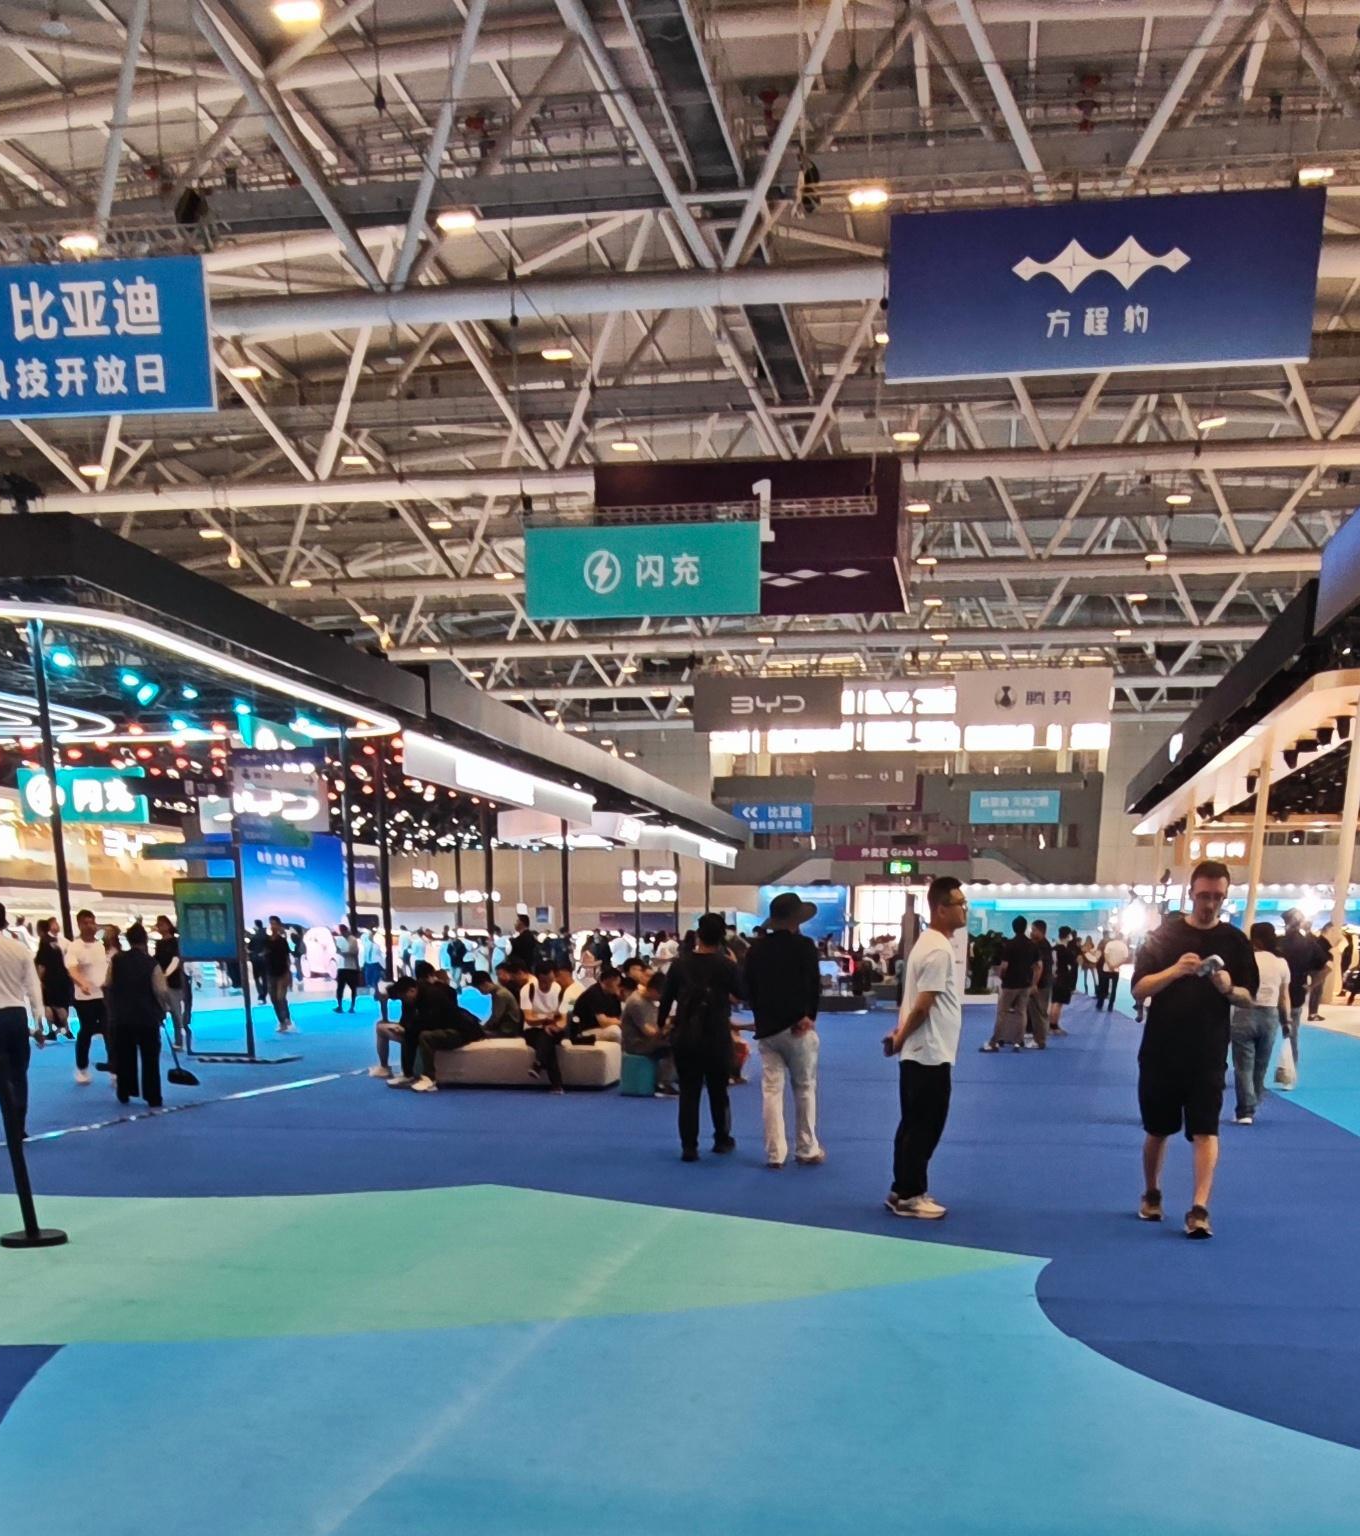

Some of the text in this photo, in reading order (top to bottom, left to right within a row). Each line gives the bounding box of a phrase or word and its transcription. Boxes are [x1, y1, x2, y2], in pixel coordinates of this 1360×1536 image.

[9, 275, 163, 342] 比亚迪
[1045, 304, 1150, 339] 方程豹
[635, 552, 701, 588] 闪充
[730, 695, 806, 714] BYD
[72, 778, 136, 813] 闪充
[890, 847, 914, 857] Grab
[924, 847, 939, 857] Go
